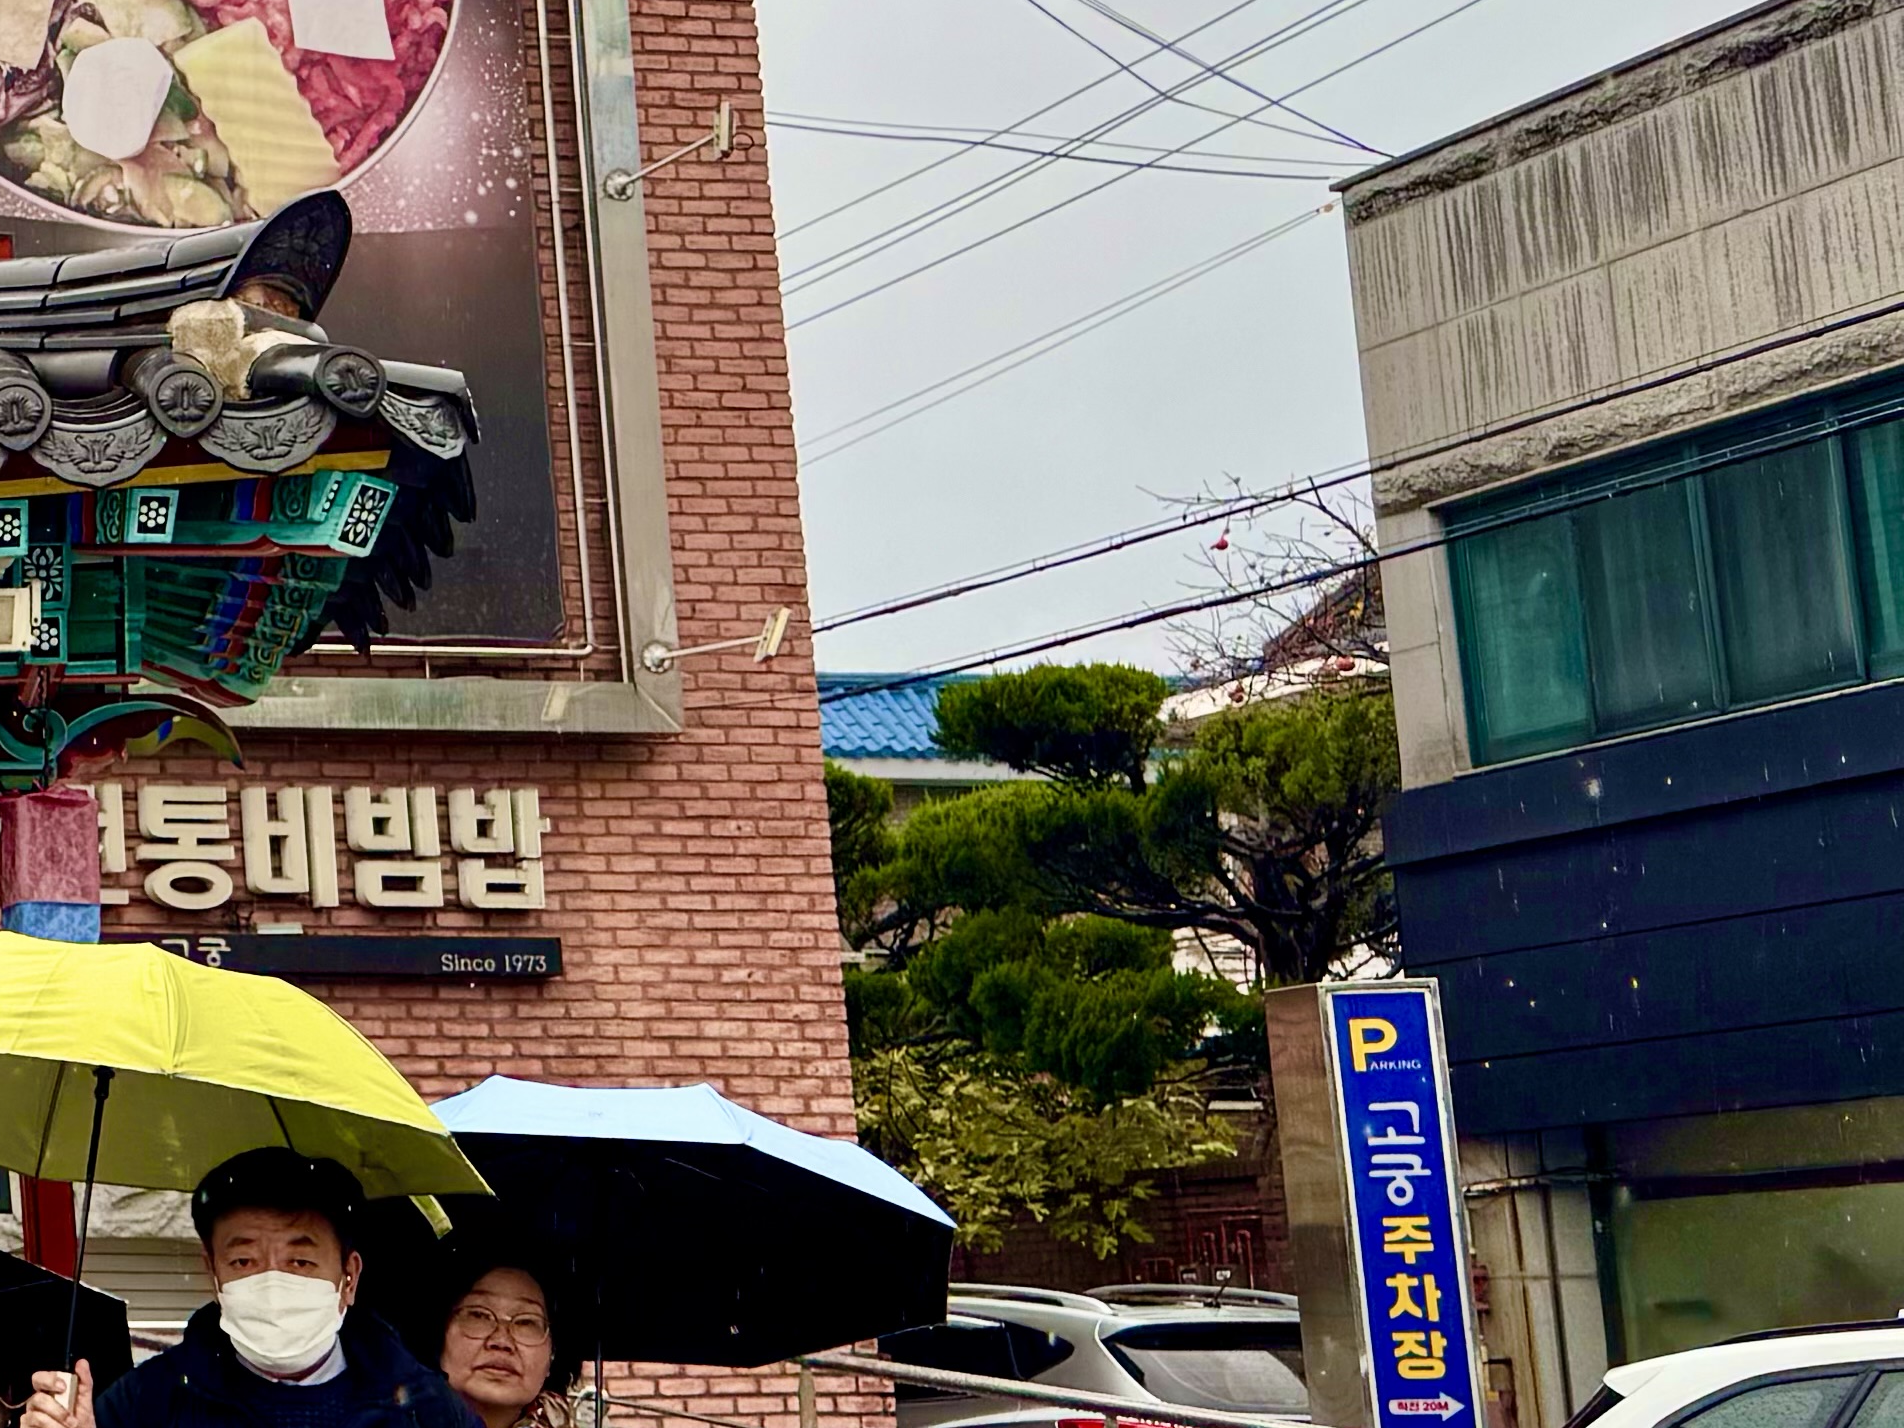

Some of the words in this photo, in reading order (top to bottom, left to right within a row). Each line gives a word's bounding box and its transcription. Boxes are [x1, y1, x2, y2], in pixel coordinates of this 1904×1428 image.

[440, 953, 496, 972] Since
[504, 954, 547, 972] 1973
[1367, 1100, 1433, 1207] 고궁
[1381, 1215, 1448, 1380] 주차장
